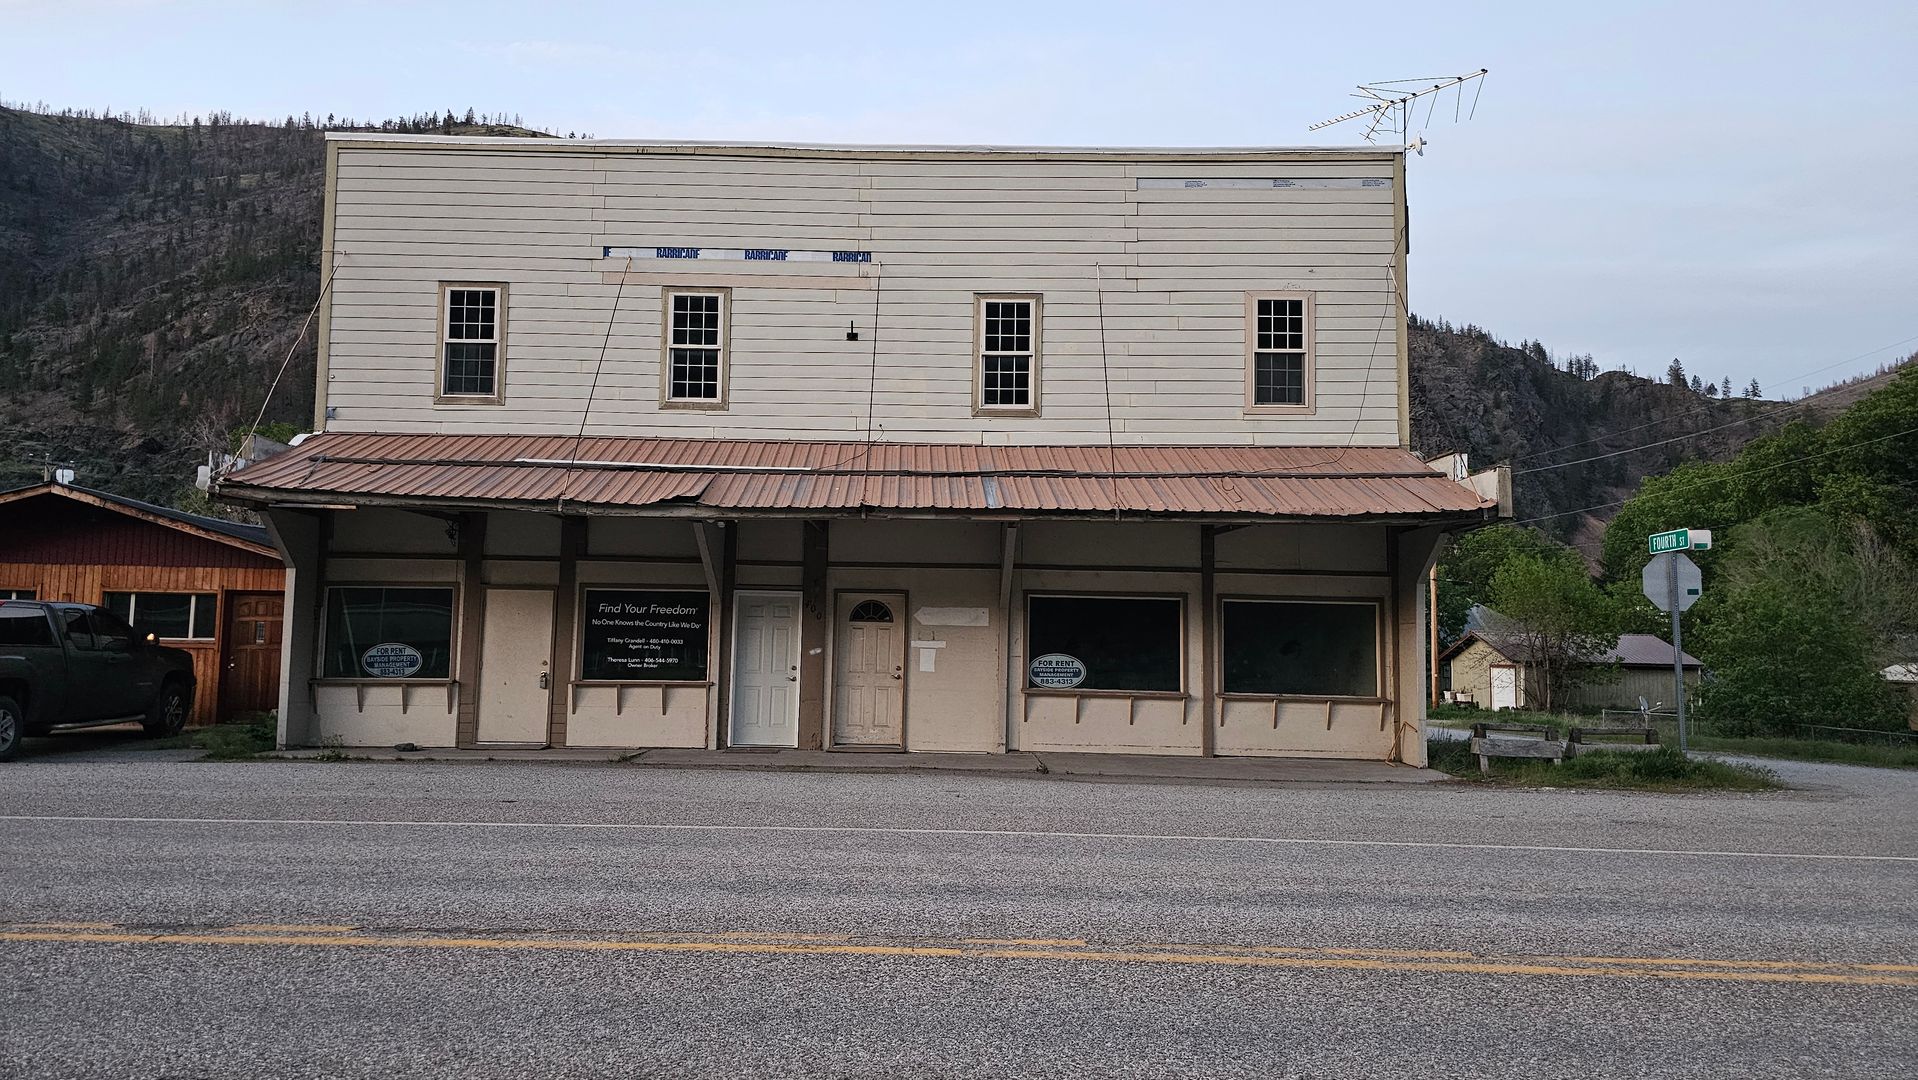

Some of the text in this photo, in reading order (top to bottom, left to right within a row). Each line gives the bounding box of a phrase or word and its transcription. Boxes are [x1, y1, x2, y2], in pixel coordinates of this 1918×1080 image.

[1653, 534, 1685, 550] FOURTH ST
[599, 603, 696, 615] Find Your Freedom
[645, 620, 667, 628] Country
